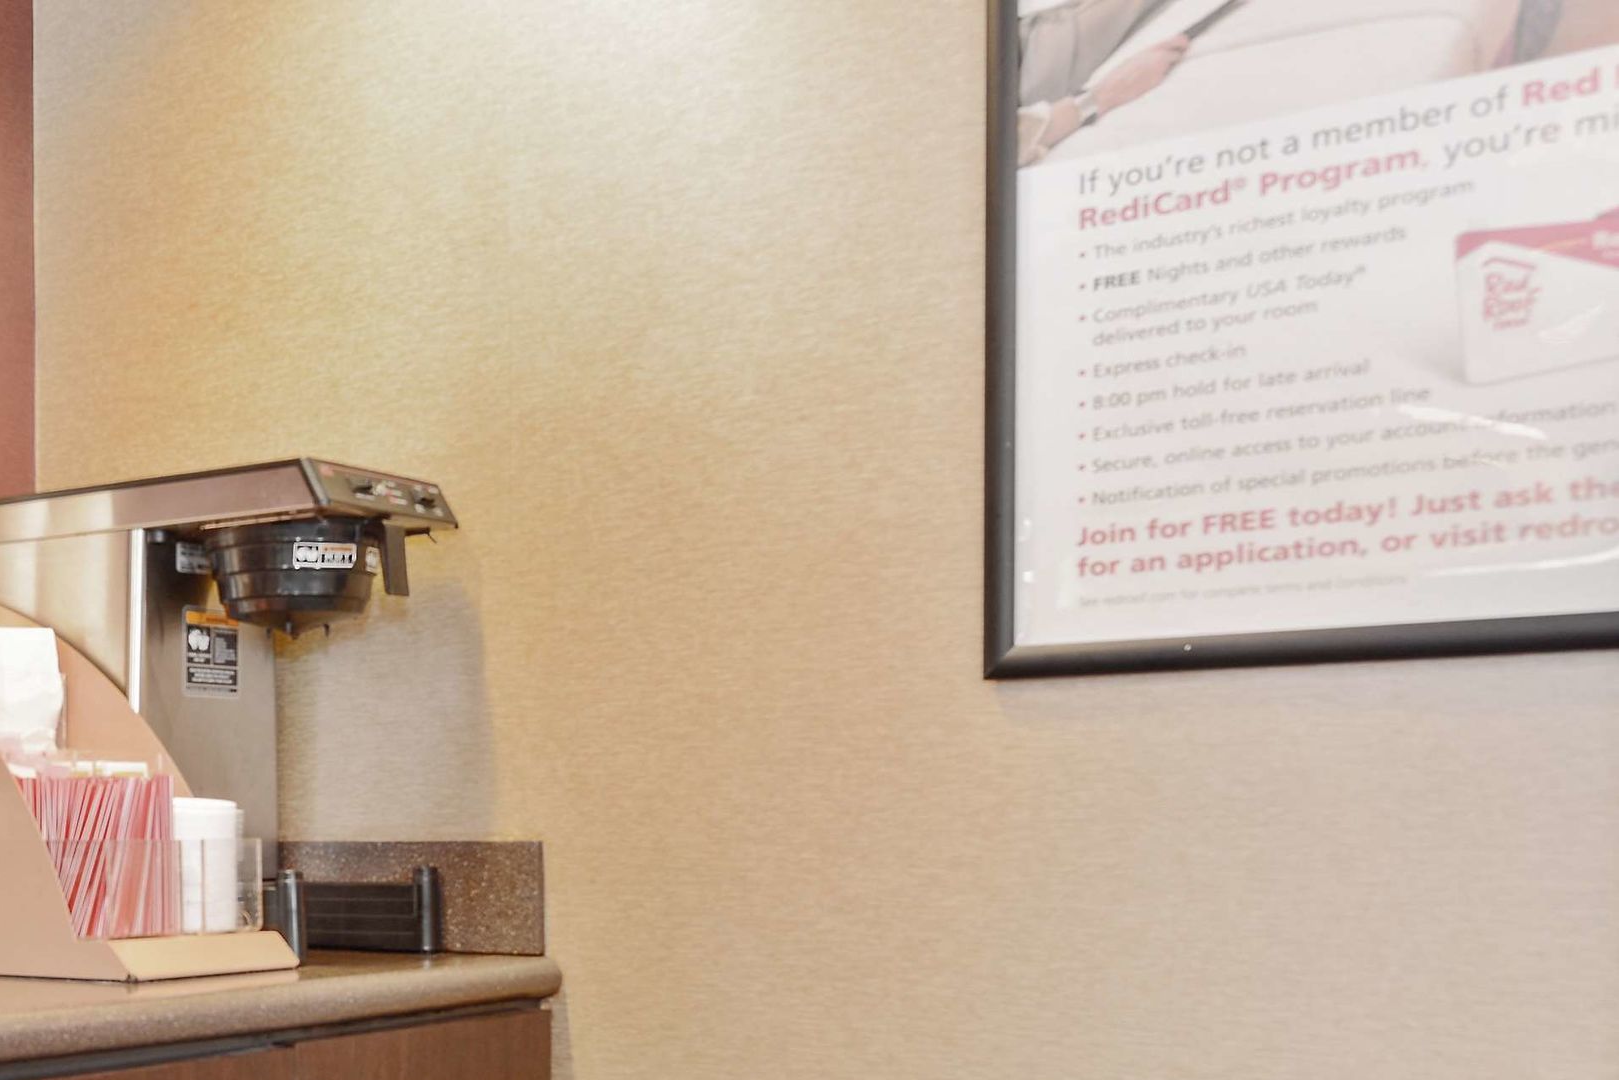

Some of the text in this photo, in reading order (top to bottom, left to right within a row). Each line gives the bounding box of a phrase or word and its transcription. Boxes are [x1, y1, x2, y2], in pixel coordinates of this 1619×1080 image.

[1079, 167, 1100, 195] If
[1109, 155, 1205, 196] you're
[1216, 138, 1270, 169] not
[1281, 134, 1301, 155] a
[1312, 104, 1457, 149] member
[1469, 84, 1508, 118] of
[1521, 66, 1600, 107] Red
[1259, 149, 1429, 197] Program,
[1443, 121, 1562, 170] you're
[1095, 180, 1475, 260] The industry's richest loyalty program
[1093, 226, 1407, 291] FREE Nights and other rewards
[1092, 289, 1240, 325] Complimentary
[1246, 278, 1288, 299] USA
[1092, 301, 1319, 347] delivered to your room
[1093, 344, 1248, 379] Express check-in
[1136, 388, 1167, 407] pm
[1172, 379, 1217, 398] hold
[1223, 376, 1252, 391] for
[1258, 370, 1297, 388] late
[1303, 358, 1371, 383] arrival
[1093, 387, 1430, 442] Exclusive toll-free reservation line
[1164, 446, 1226, 466] online
[1231, 439, 1292, 458] access
[1297, 434, 1320, 450] to
[1326, 430, 1375, 450] your
[1092, 482, 1204, 505] Notification
[1210, 475, 1231, 493] of
[1237, 468, 1305, 492] special
[1311, 459, 1436, 485] promotions
[1077, 523, 1137, 546] Join
[1146, 518, 1193, 540] for
[1202, 507, 1276, 535] FREE
[1287, 496, 1398, 527] today!
[1410, 489, 1482, 517] Just
[1493, 481, 1554, 509] ask
[1077, 556, 1120, 577] for
[1130, 554, 1167, 574] an
[1176, 536, 1369, 573] application,
[1380, 533, 1418, 552] or
[1430, 522, 1507, 549] visit
